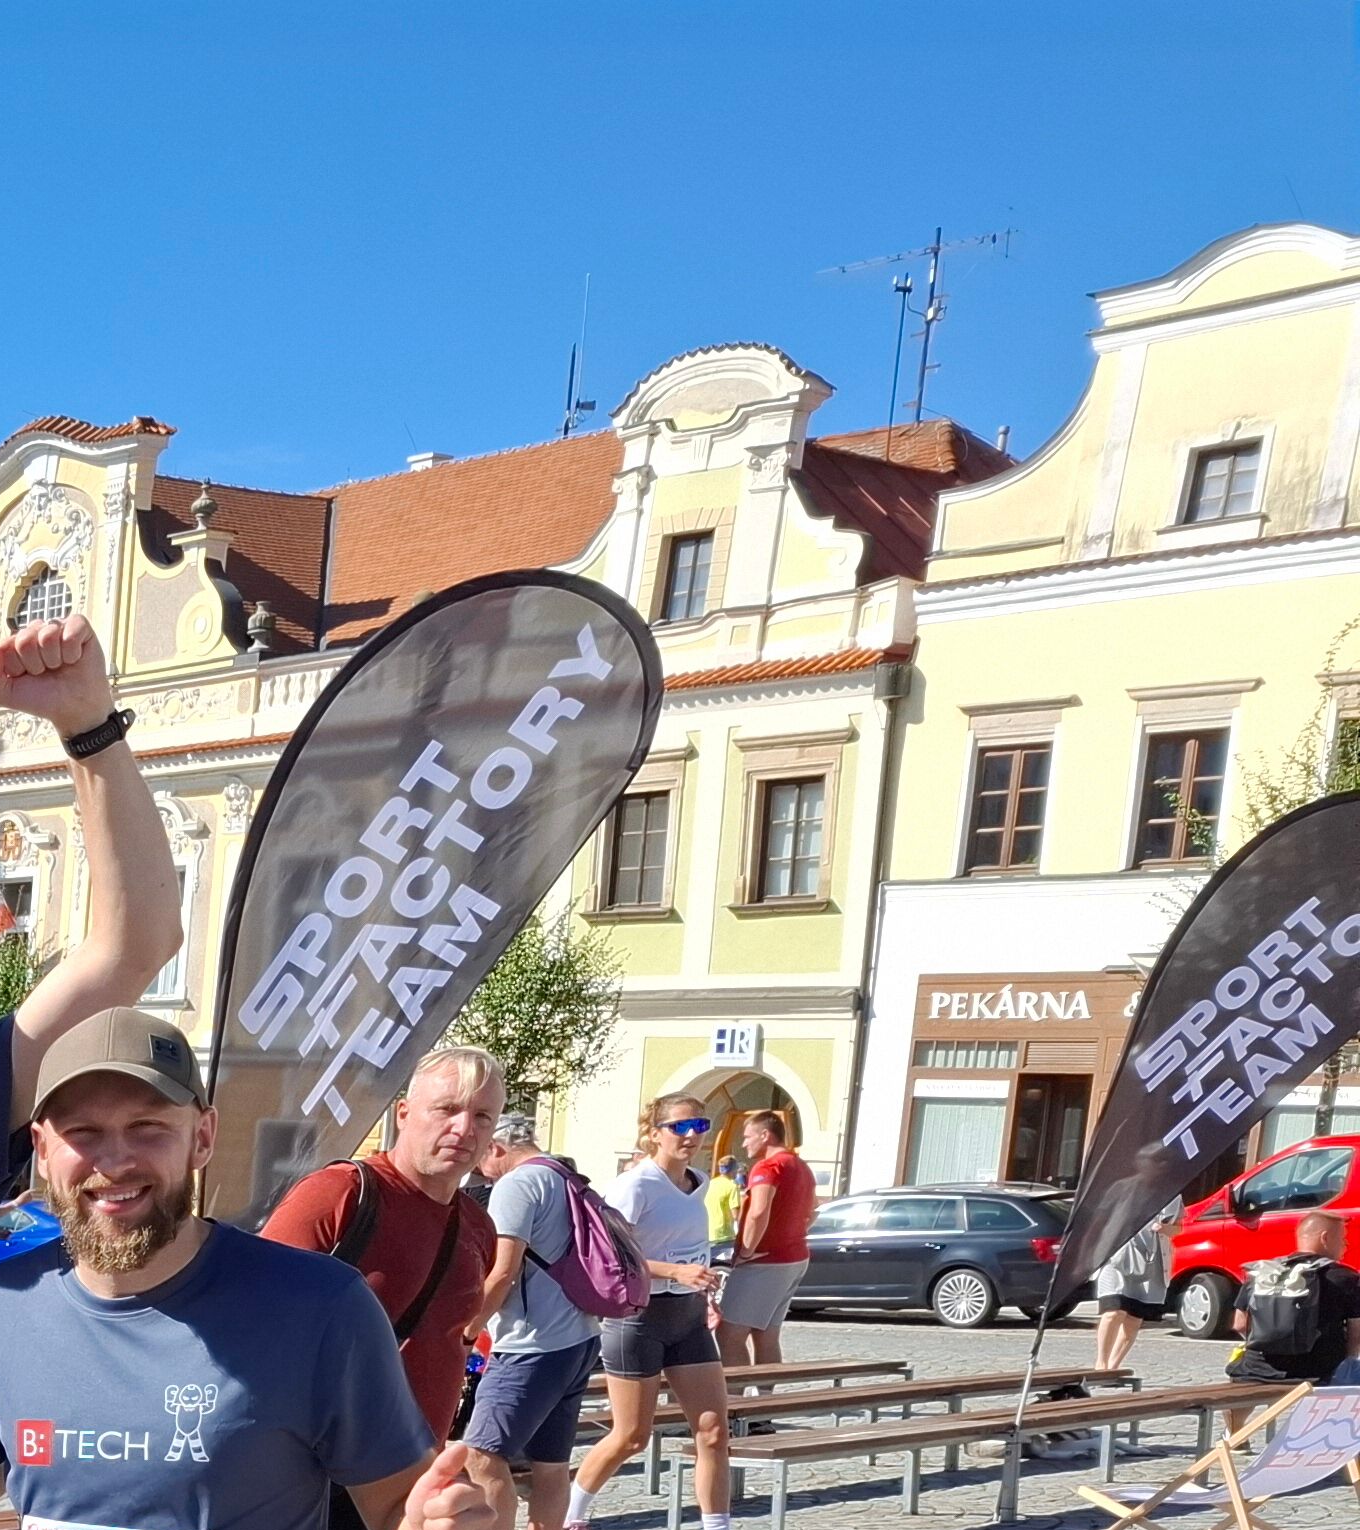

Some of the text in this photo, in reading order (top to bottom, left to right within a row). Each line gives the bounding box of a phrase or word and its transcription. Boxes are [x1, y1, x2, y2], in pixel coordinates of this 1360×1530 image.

[238, 738, 461, 1051] SPORT
[298, 621, 615, 1058] FACTORY
[300, 884, 502, 1128] TEAM
[928, 983, 1092, 1022] PEKÁRNA
[1134, 895, 1328, 1093] SPORT
[1162, 1002, 1336, 1161] TEAM
